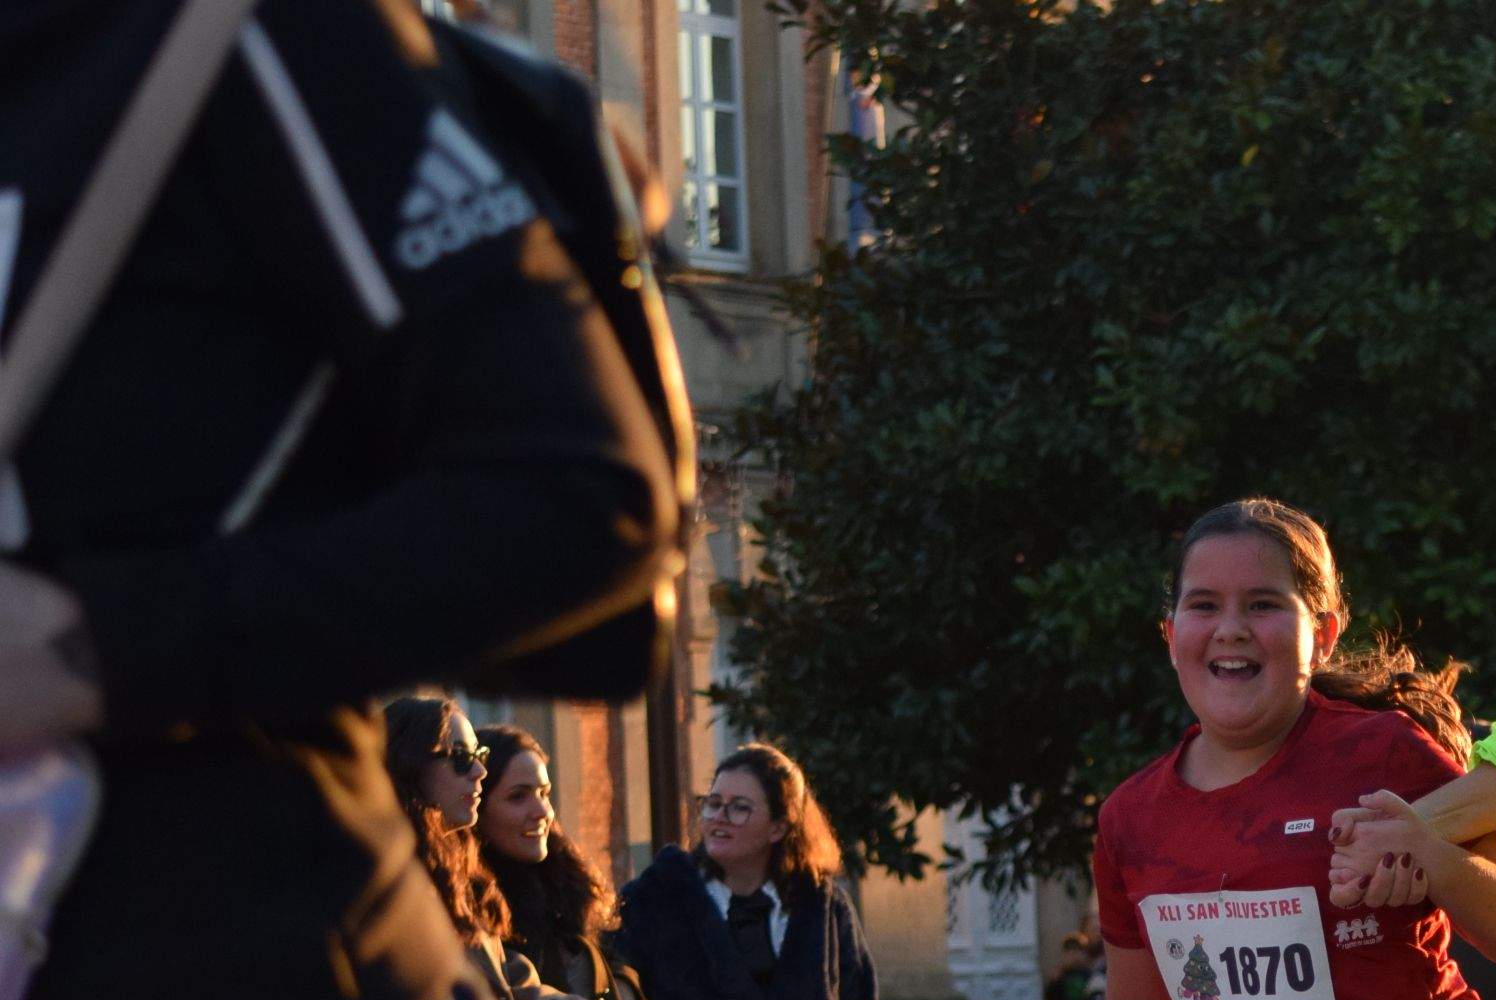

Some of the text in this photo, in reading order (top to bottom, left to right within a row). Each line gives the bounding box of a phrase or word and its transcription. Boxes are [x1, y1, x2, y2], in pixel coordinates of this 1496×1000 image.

[396, 182, 535, 269] adidas
[1157, 898, 1303, 922] XLI SAN SILVESTRE
[1219, 943, 1316, 996] 1870
